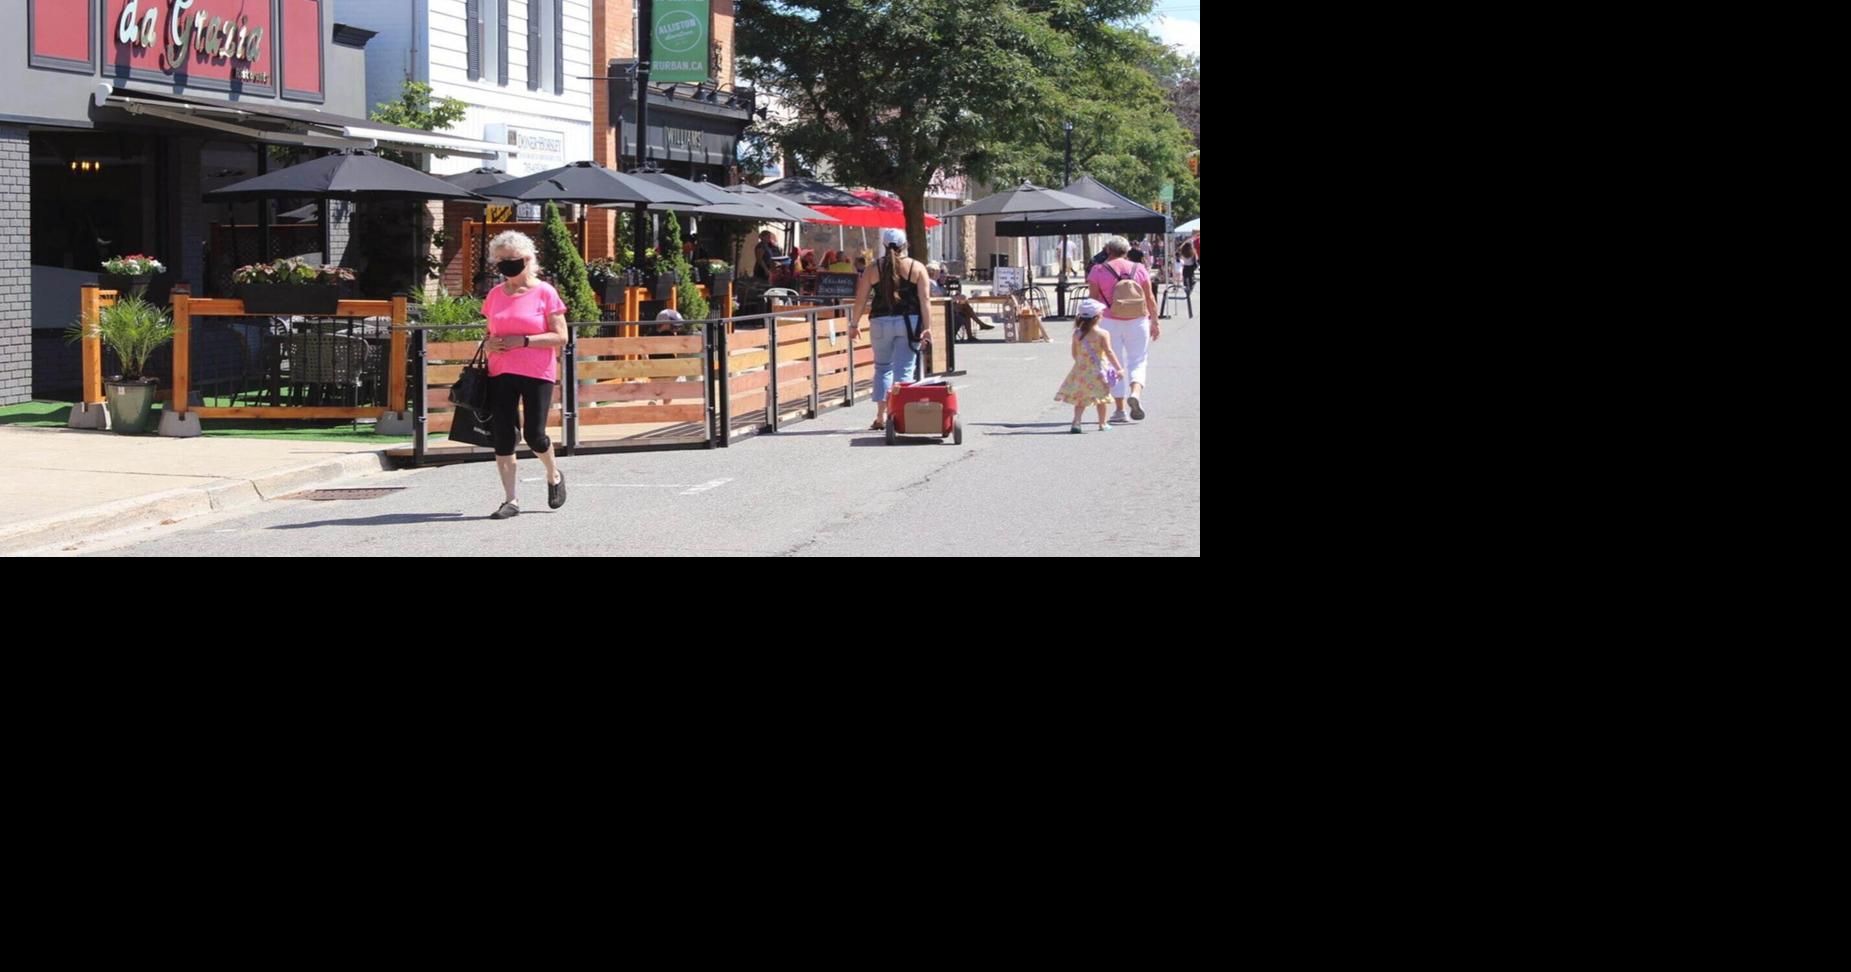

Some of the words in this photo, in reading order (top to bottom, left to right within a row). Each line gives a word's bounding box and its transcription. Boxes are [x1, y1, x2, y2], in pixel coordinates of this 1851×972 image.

[119, 0, 158, 48] da
[167, 0, 263, 69] Grazia
[659, 19, 696, 35] ALLISTON
